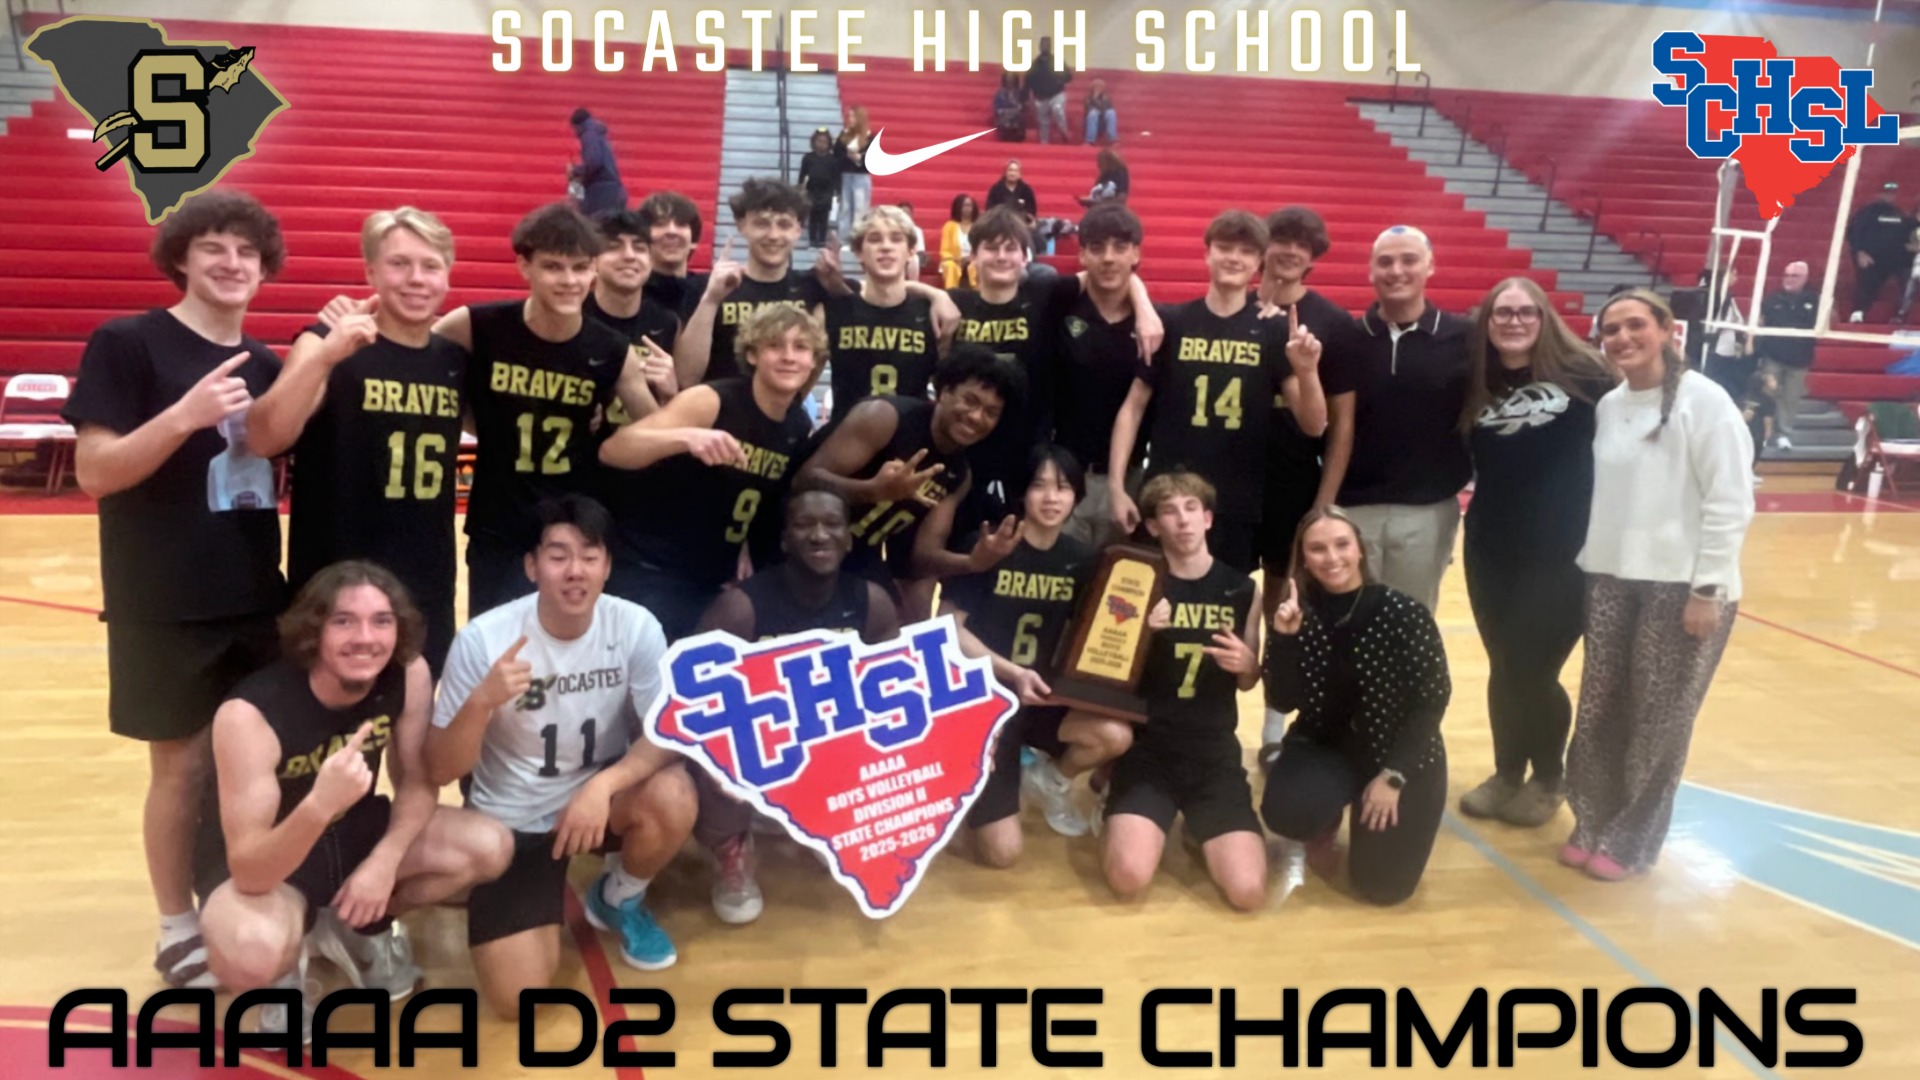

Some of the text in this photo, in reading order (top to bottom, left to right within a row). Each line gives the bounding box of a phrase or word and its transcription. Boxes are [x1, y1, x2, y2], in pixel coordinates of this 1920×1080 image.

[839, 326, 925, 353] BRAVES
[1178, 336, 1261, 366] BRAVES
[362, 378, 459, 418] BRAVES
[490, 361, 596, 406] BRAVES
[1191, 374, 1243, 429] 14
[384, 430, 446, 500] 16
[515, 412, 573, 475] 12
[725, 488, 761, 544] 9
[993, 569, 1075, 600] BRAVES
[1011, 612, 1043, 667] 6
[1174, 642, 1204, 698] 7
[669, 625, 990, 790] SCHSL
[538, 717, 597, 778] 11
[859, 754, 906, 781] AAAAA
[826, 762, 944, 813] BOYS VOLLEYBALL
[852, 791, 914, 823] DIVISION
[831, 797, 954, 851] STATE CHAMPIONS
[859, 823, 936, 862] 2025-2026
